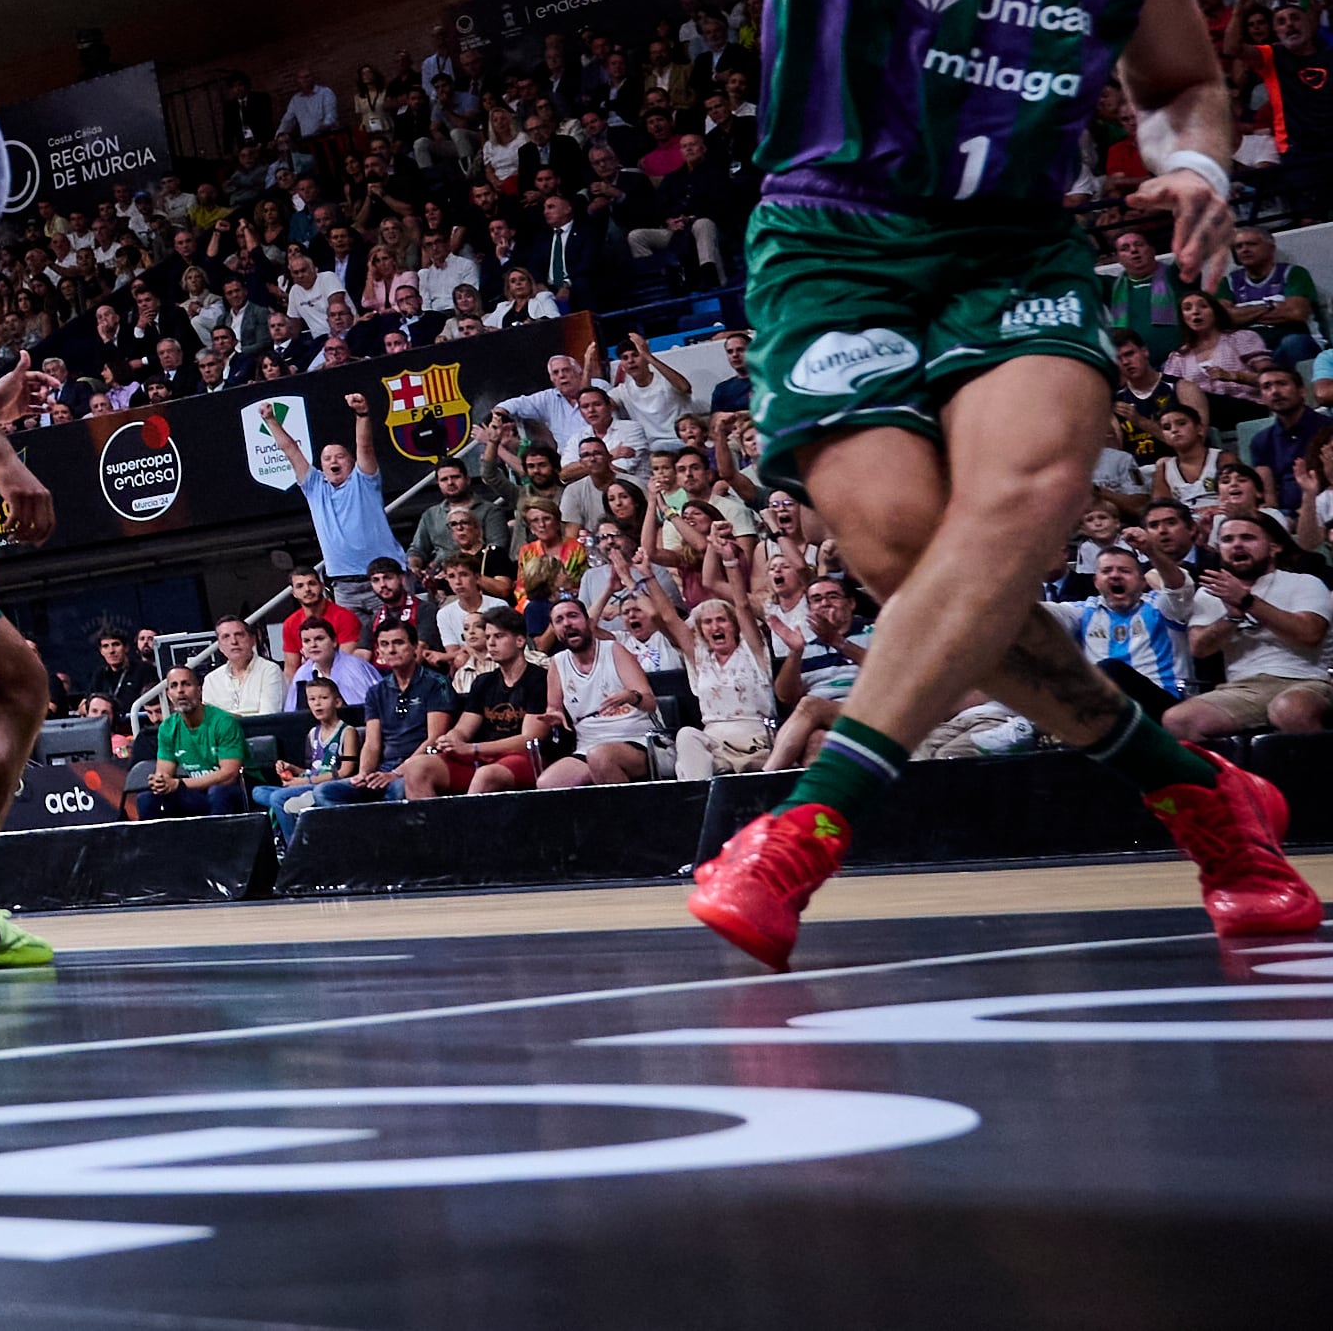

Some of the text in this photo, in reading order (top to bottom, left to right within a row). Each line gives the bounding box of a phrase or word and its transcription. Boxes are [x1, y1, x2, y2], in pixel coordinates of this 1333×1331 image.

[48, 134, 73, 148] Costa
[50, 135, 121, 171] REGIÓN
[53, 147, 157, 190] DE MURCIA
[953, 134, 992, 201] 1
[106, 452, 174, 476] supercopa
[113, 467, 176, 492] endesa
[134, 499, 159, 511] Murcia
[44, 785, 95, 815] acb
